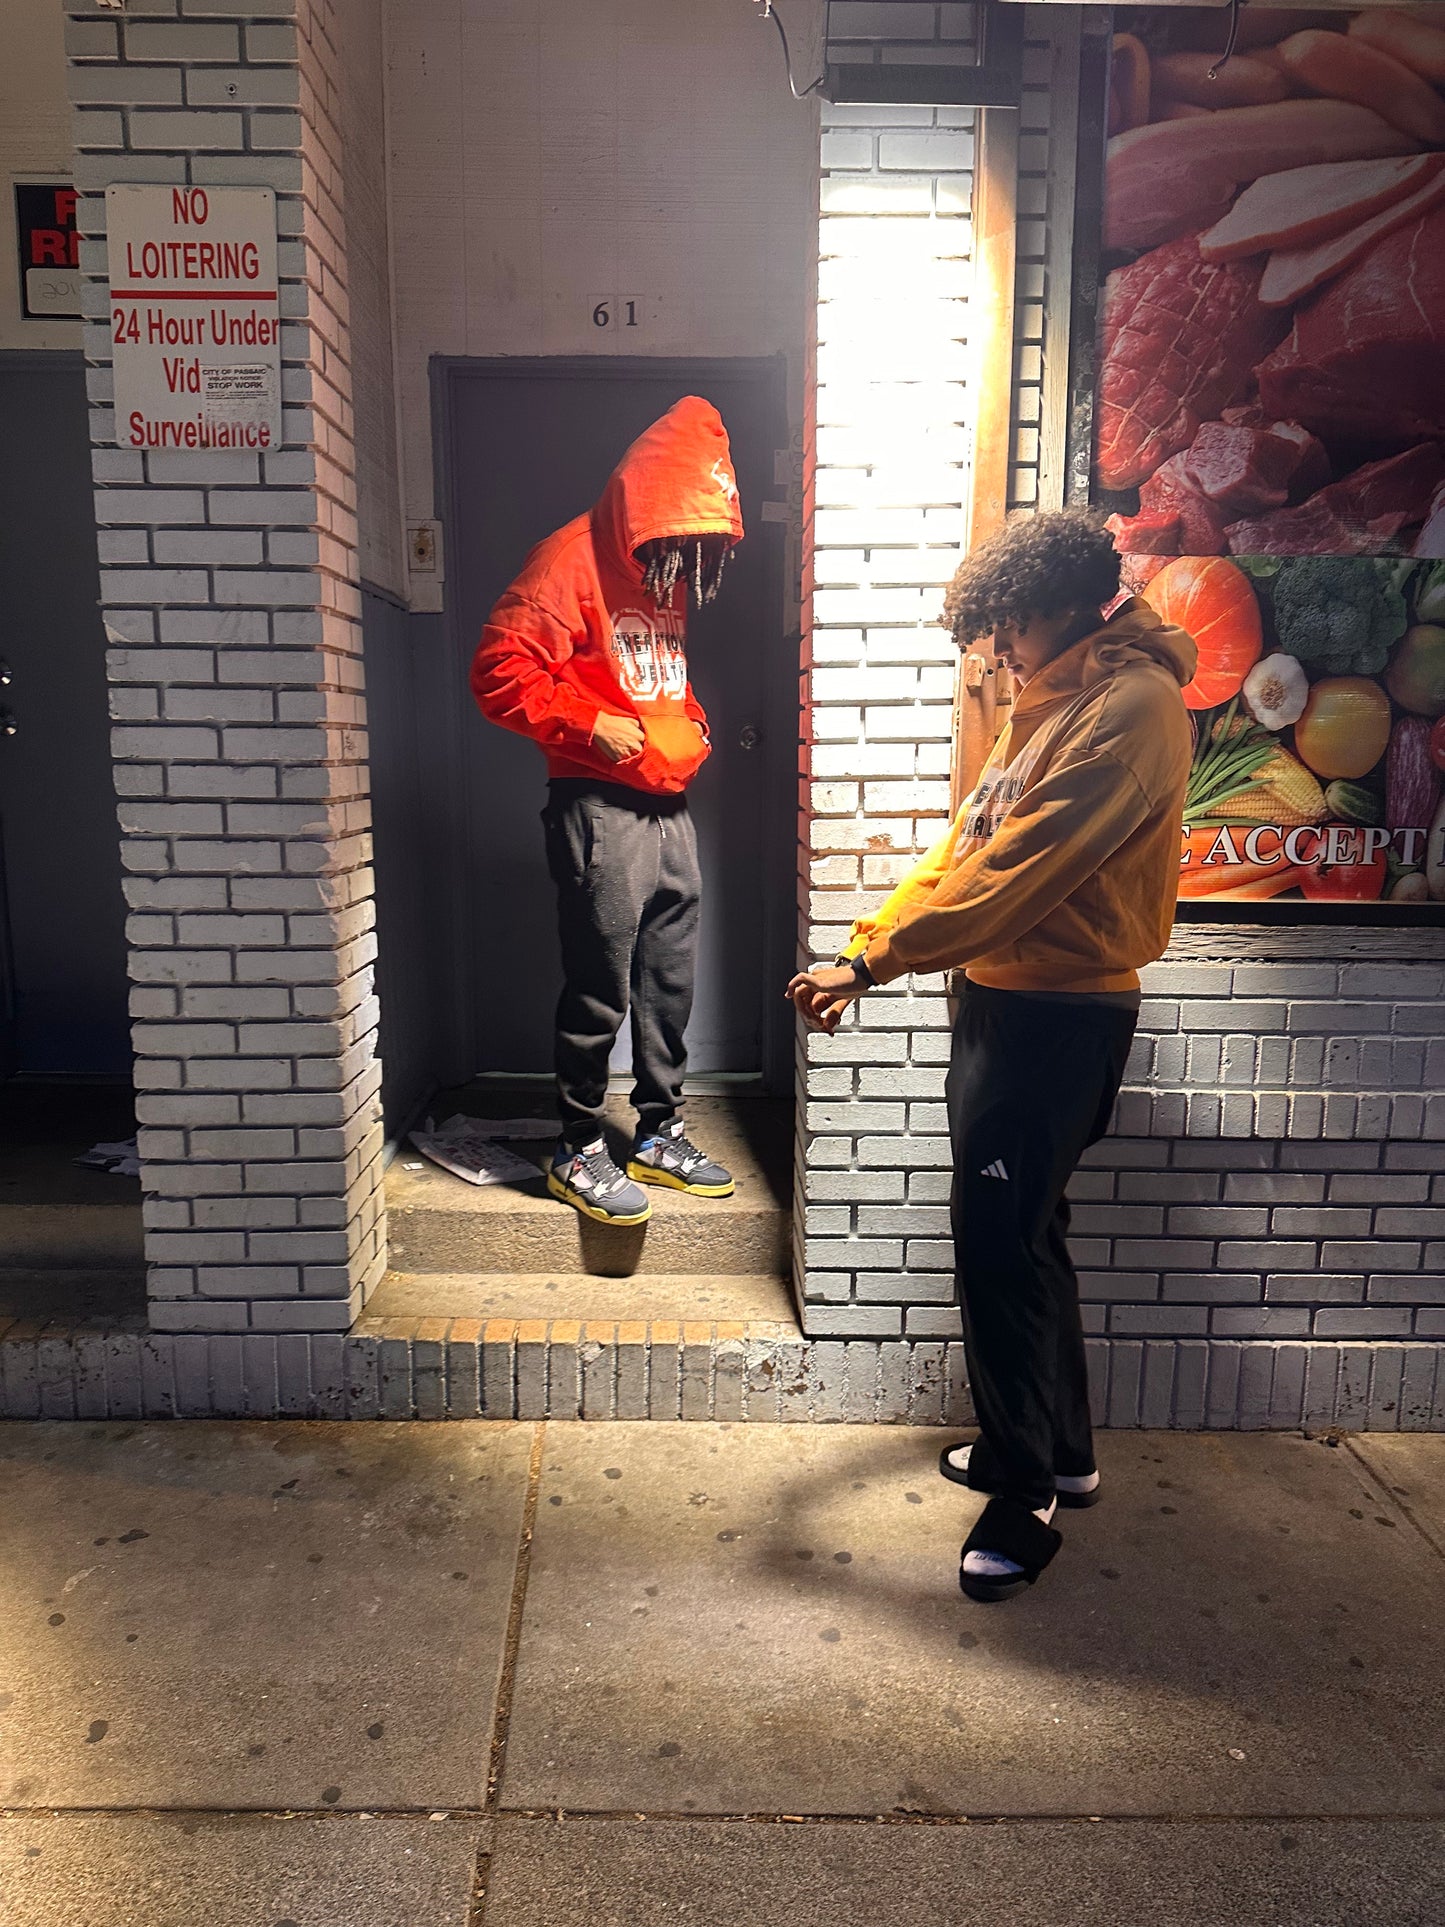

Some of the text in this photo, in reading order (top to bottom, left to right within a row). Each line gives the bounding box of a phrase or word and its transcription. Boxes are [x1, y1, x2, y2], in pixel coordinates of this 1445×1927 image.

[172, 187, 209, 225] NO
[127, 242, 260, 279] LOITERING
[113, 308, 279, 346] 24 Hour Under
[234, 381, 264, 389] WORK
[129, 412, 271, 447] Surveillance
[1202, 824, 1428, 867] ACCEPT
